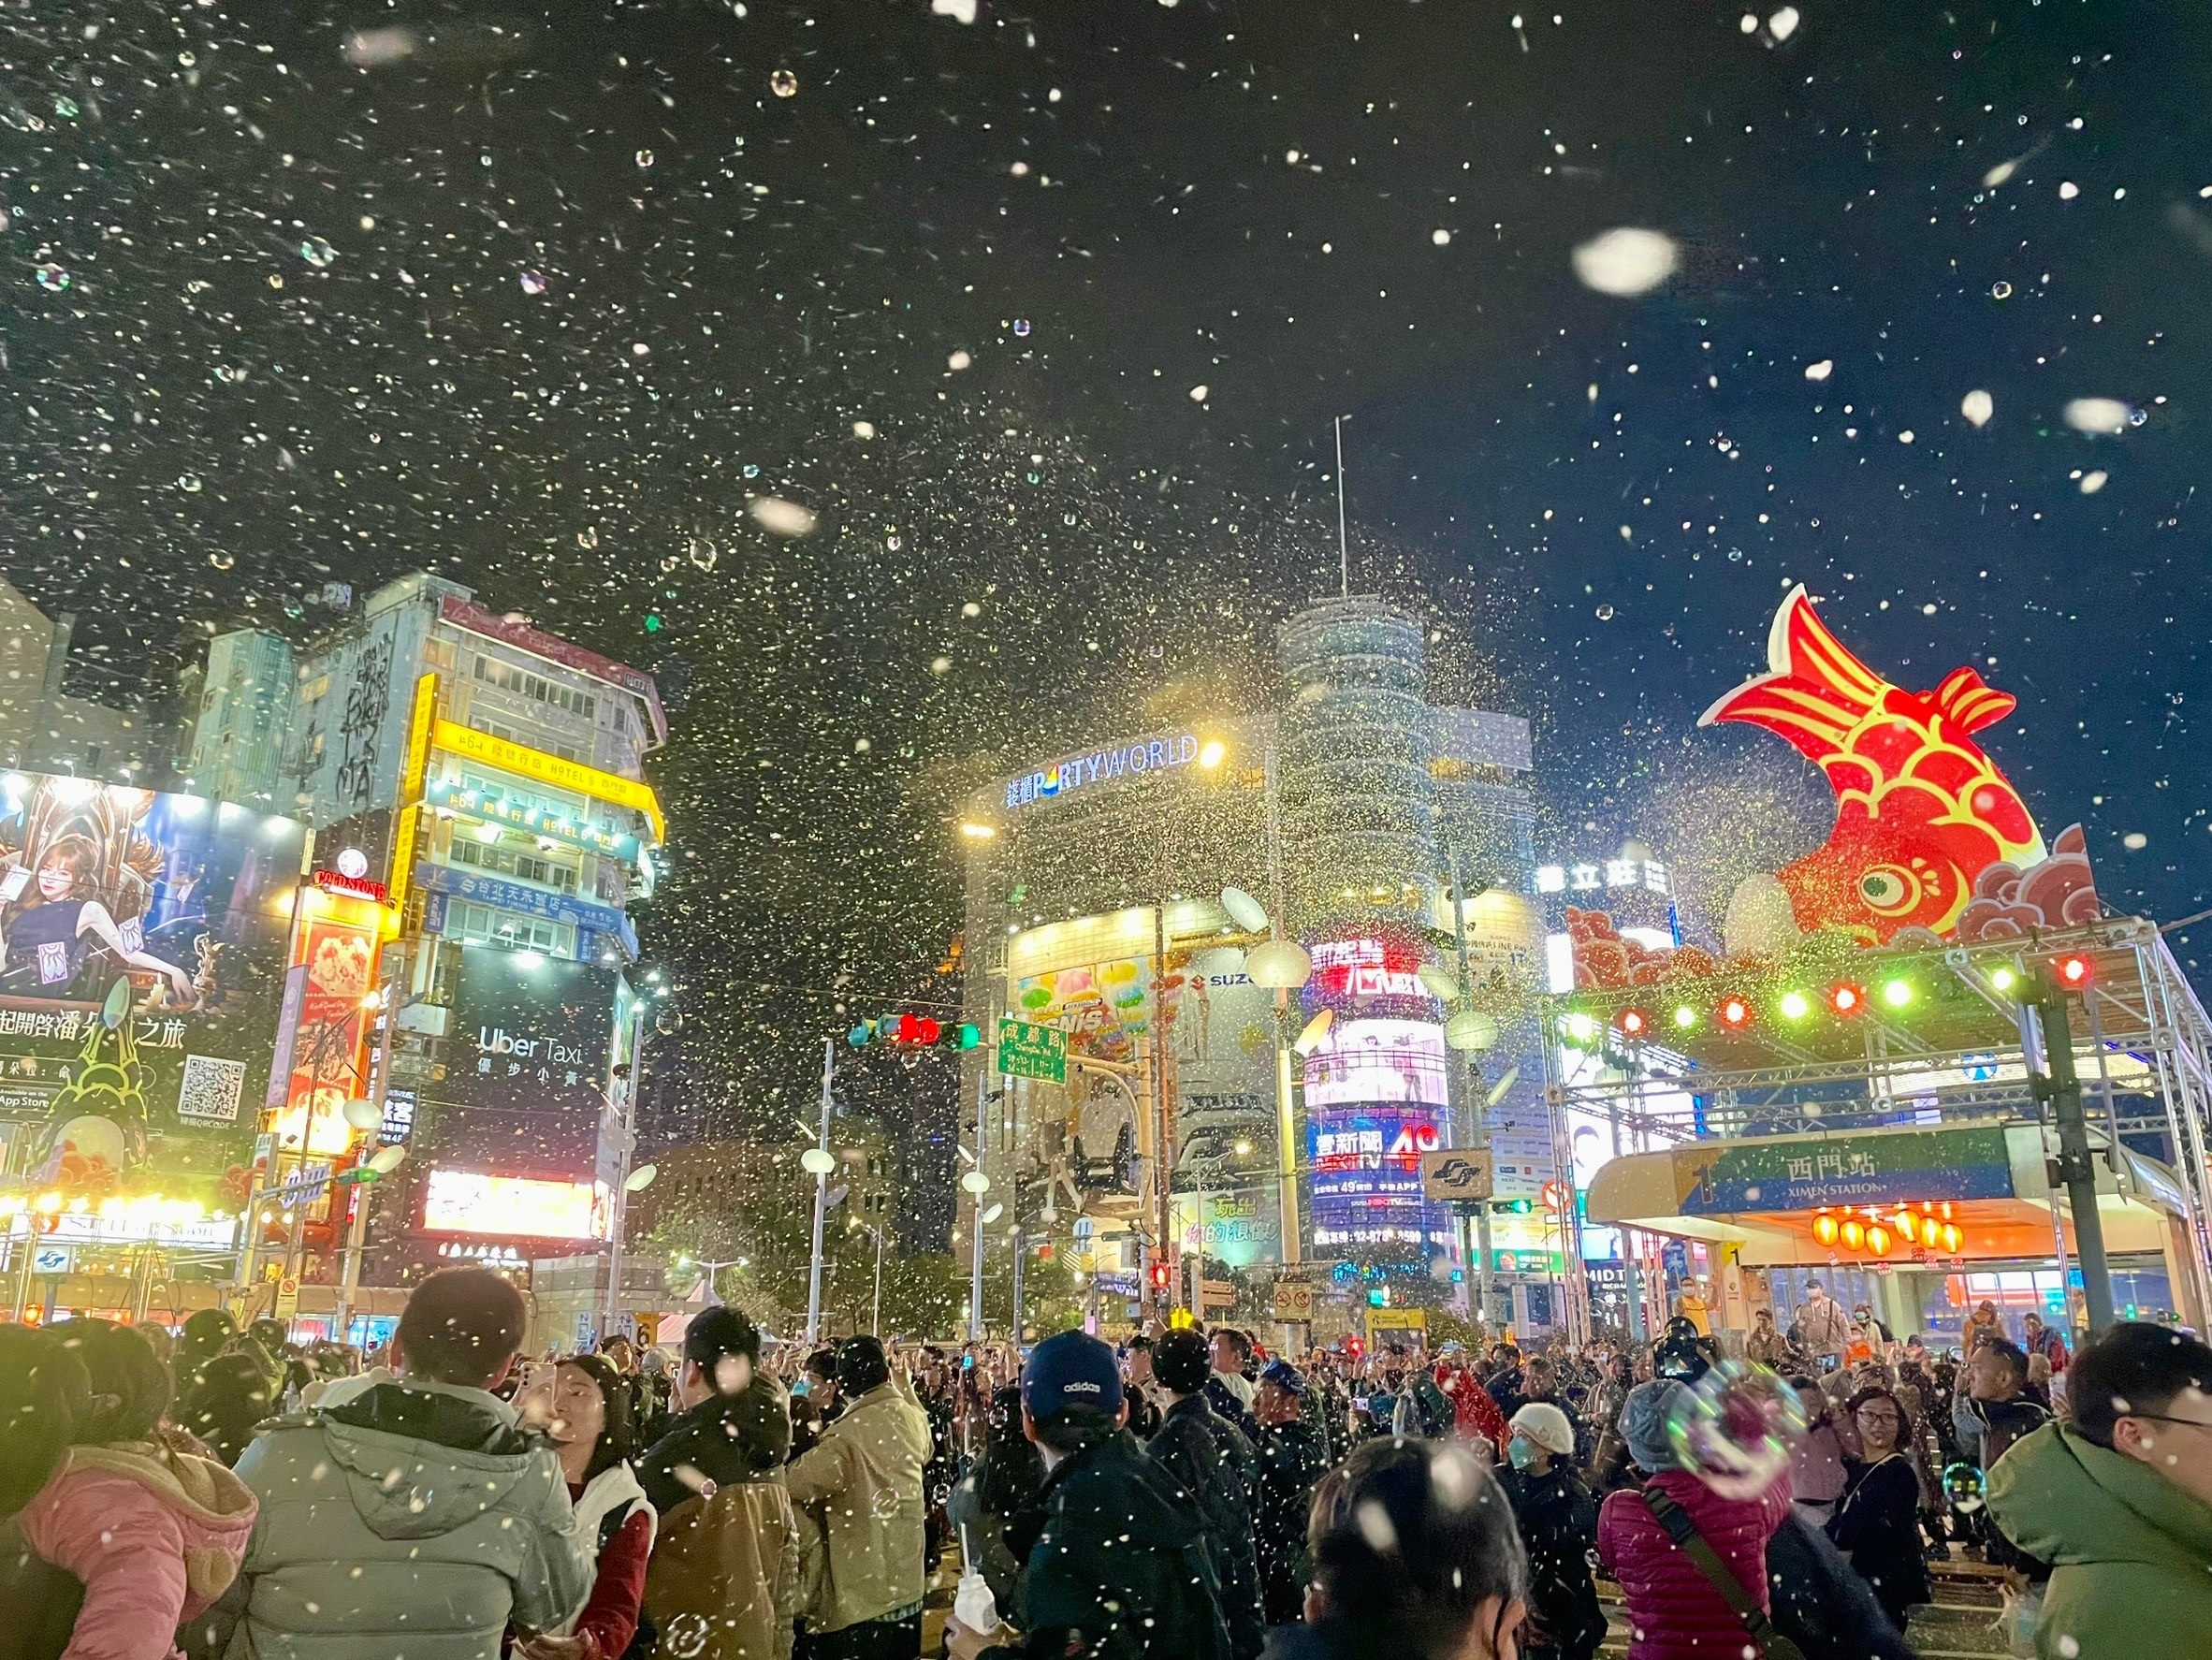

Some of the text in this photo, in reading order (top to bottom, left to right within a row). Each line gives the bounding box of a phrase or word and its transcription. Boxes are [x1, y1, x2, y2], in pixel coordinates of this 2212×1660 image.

[1210, 973, 1255, 986] SUZ
[1006, 1023, 1059, 1047] 成都路
[480, 1026, 583, 1065] Uber Taxi
[0, 1096, 50, 1108] App Store
[1786, 1152, 1875, 1182] 西門站
[1692, 1163, 1713, 1202] 1
[1788, 1183, 1882, 1199] XIMEN STATION
[1215, 1197, 1258, 1217] 玩出
[1729, 1247, 1740, 1267] 1
[637, 1323, 650, 1347] 6
[1064, 1381, 1100, 1392] adidas
